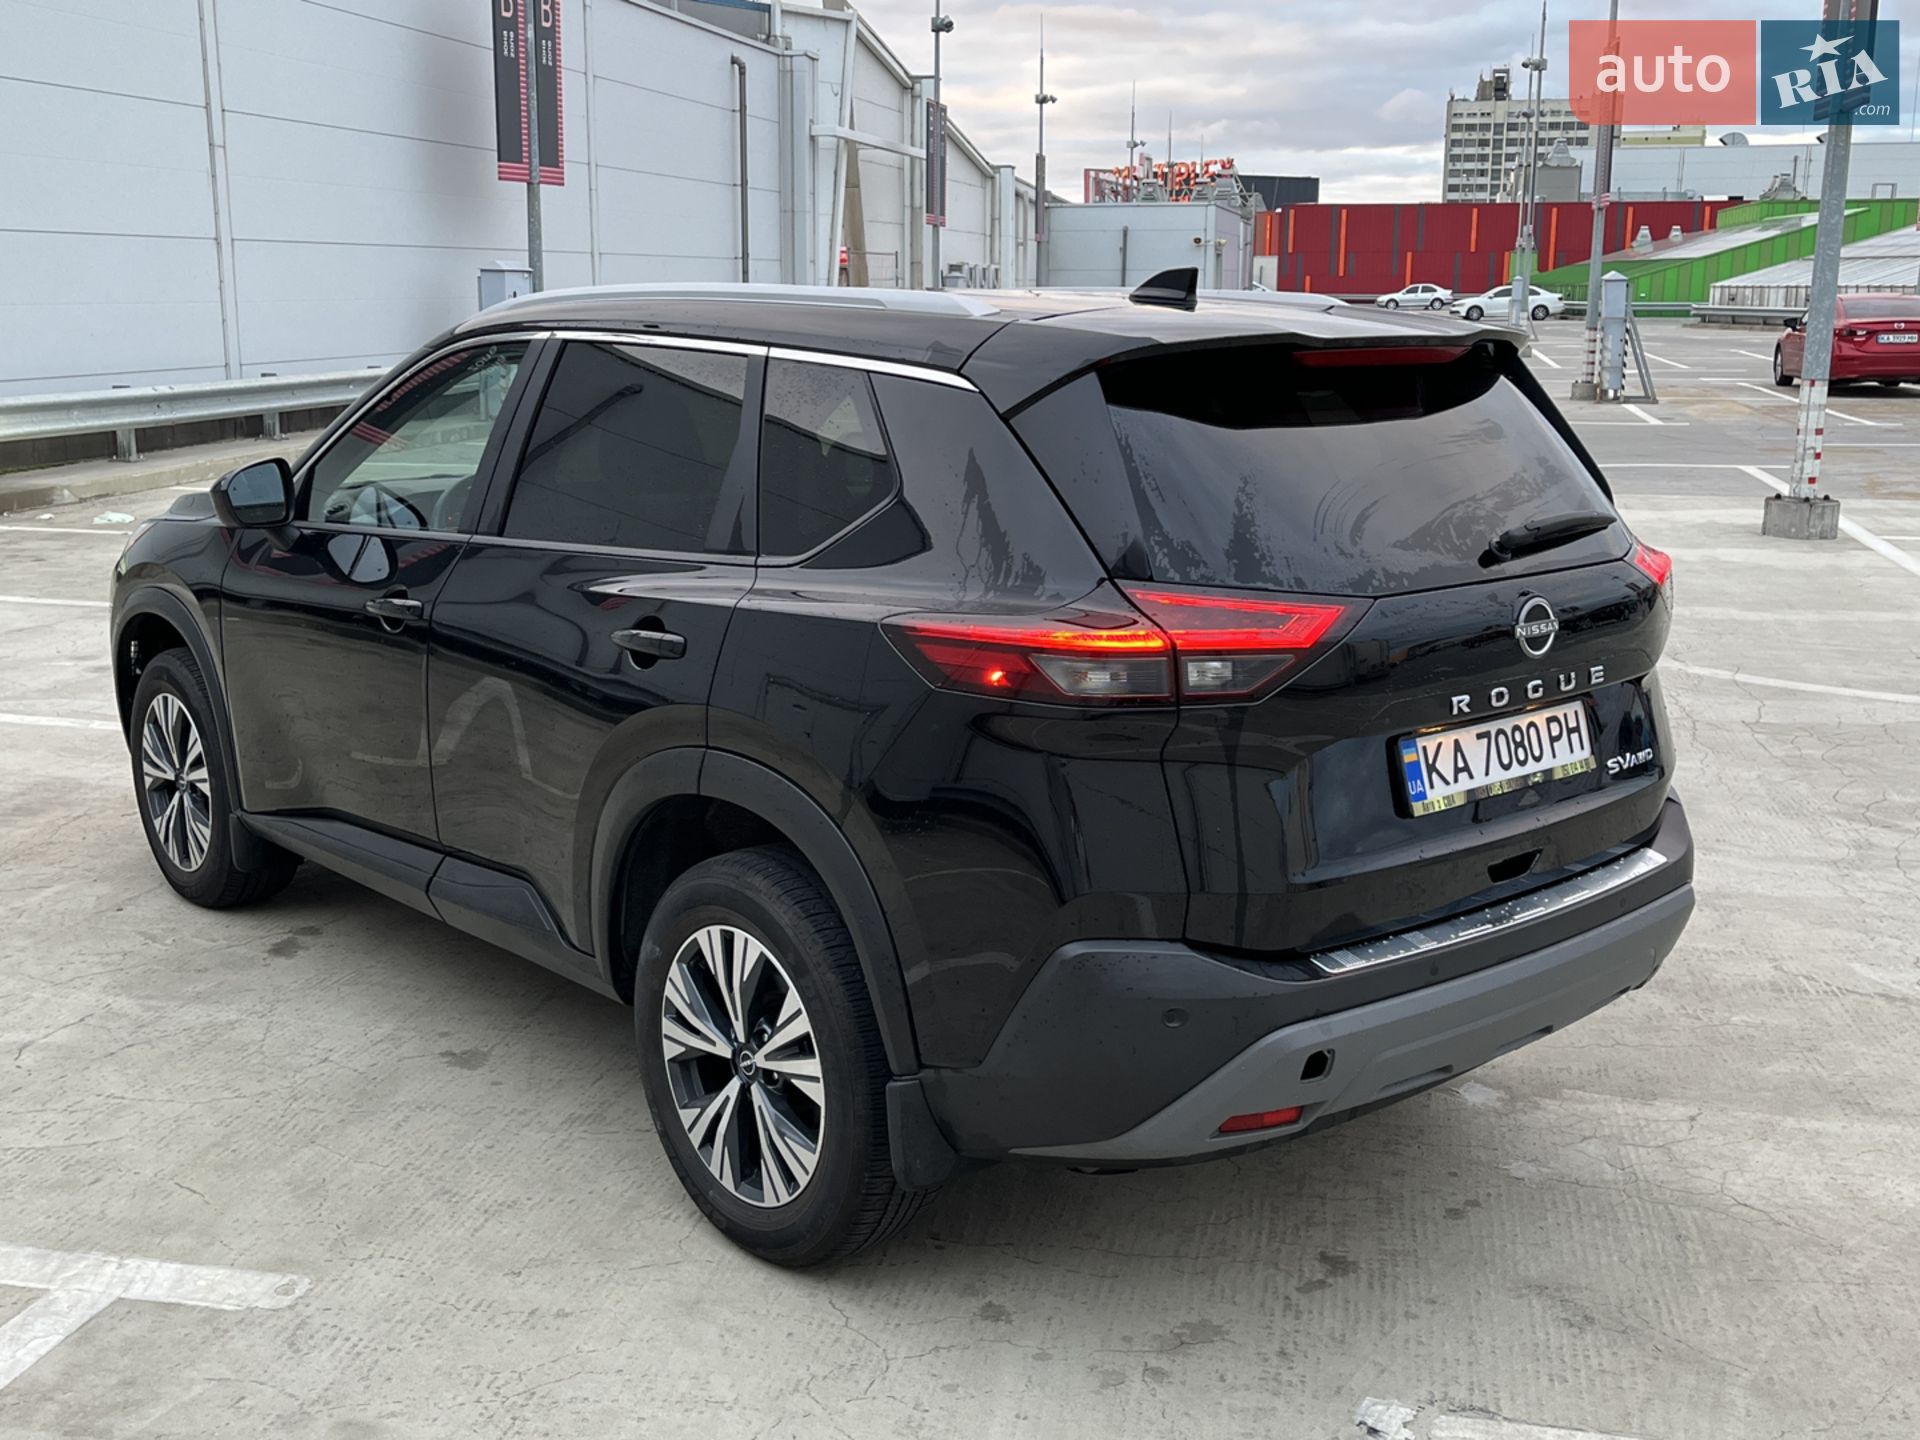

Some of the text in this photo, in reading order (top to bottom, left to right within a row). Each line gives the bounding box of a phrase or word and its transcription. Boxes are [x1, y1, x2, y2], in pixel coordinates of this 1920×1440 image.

[1516, 620, 1559, 638] NISSAN
[1451, 665, 1605, 716] ROGUE
[1422, 709, 1585, 789] KA 7080 PH
[1409, 780, 1424, 795] UA
